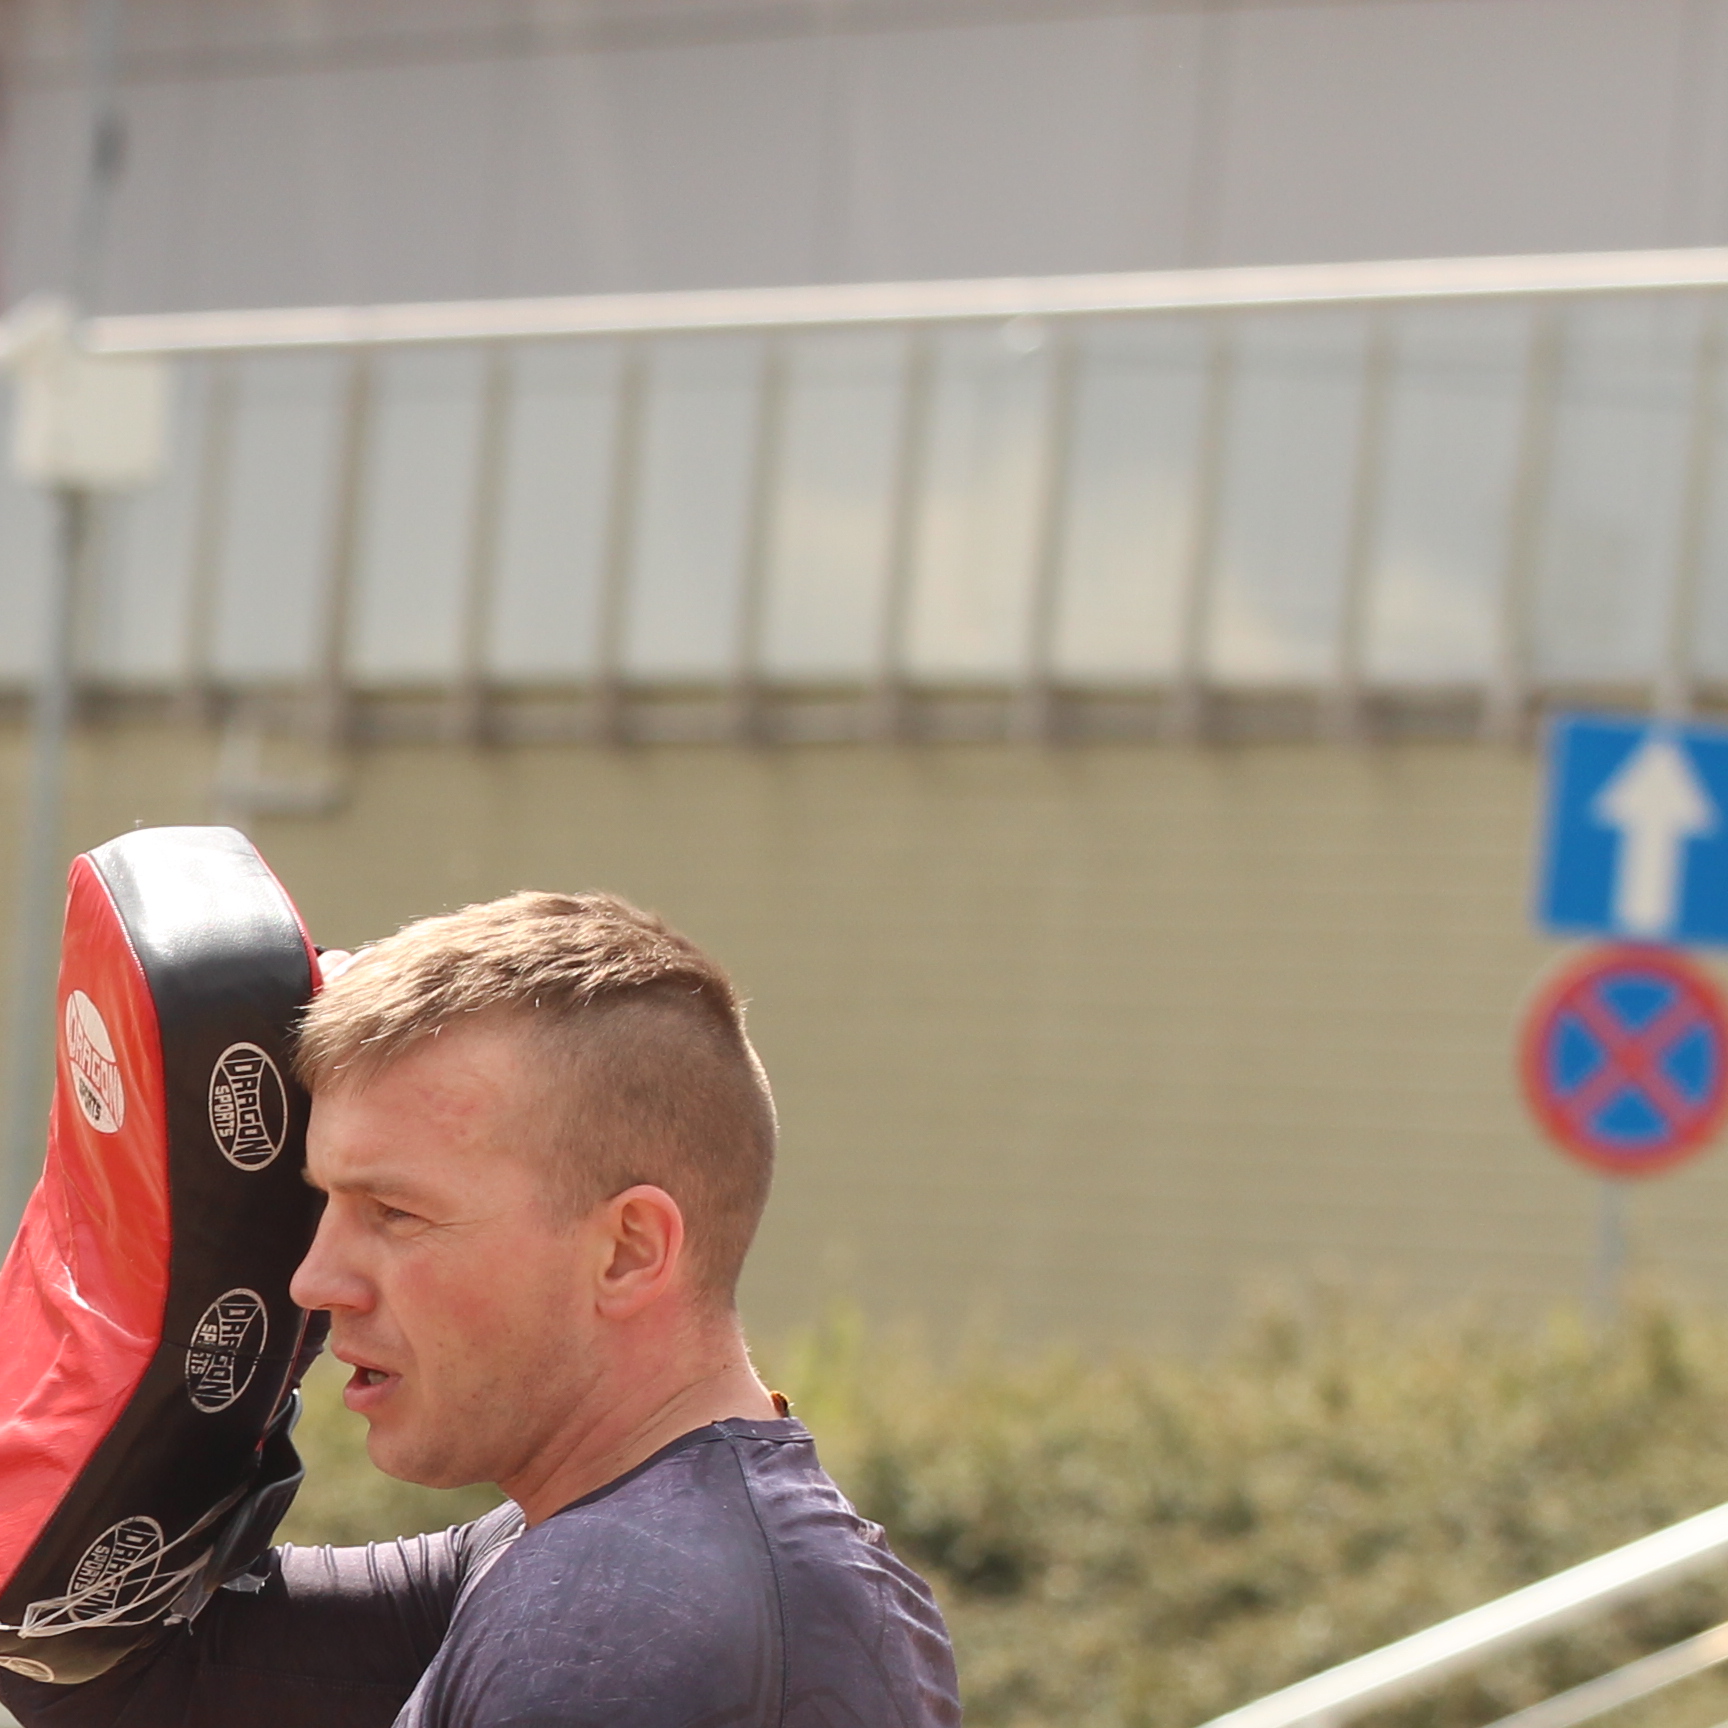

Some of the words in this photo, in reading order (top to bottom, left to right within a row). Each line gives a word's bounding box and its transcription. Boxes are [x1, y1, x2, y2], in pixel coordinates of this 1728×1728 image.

[68, 1000, 120, 1128] DRAGON
[214, 1084, 235, 1138] SPORTS
[224, 1060, 274, 1157] DRAGON
